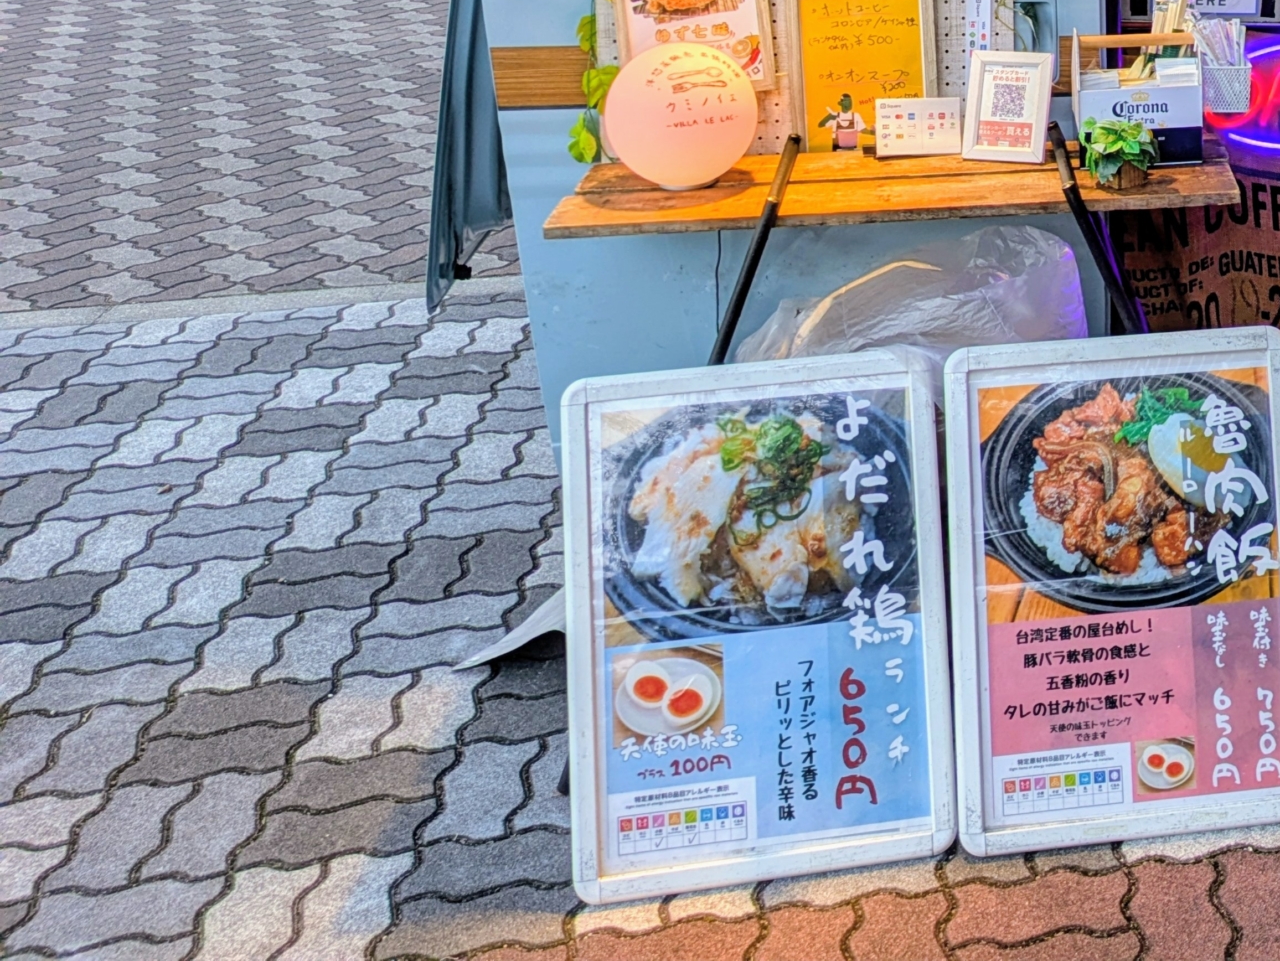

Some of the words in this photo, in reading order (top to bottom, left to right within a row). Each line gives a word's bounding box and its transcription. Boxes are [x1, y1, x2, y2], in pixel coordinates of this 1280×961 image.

[1006, 126, 1030, 136] 買える
[1112, 100, 1169, 118] Corona
[1200, 393, 1279, 584] 魯肉飯
[836, 395, 914, 650] よだれ鶏
[1023, 643, 1151, 669] 豚バラ軟骨の食感と
[1207, 610, 1229, 668] 味玉なし
[1249, 606, 1272, 669] 味玉付き
[1046, 668, 1130, 691] 五香粉の香り
[885, 658, 911, 770] ランチ
[1003, 688, 1175, 720] タレの甘みがご飯にマッチ
[1049, 716, 1132, 734] 天使の味玉トッピング
[619, 724, 744, 762] 天使の味玉
[775, 680, 796, 822] ピリッとした辛味
[798, 660, 819, 802] フォアジャオ香る
[835, 667, 878, 810] 650円
[1075, 730, 1108, 742] できます
[1212, 687, 1241, 788] 650円
[669, 754, 732, 777] 100円
